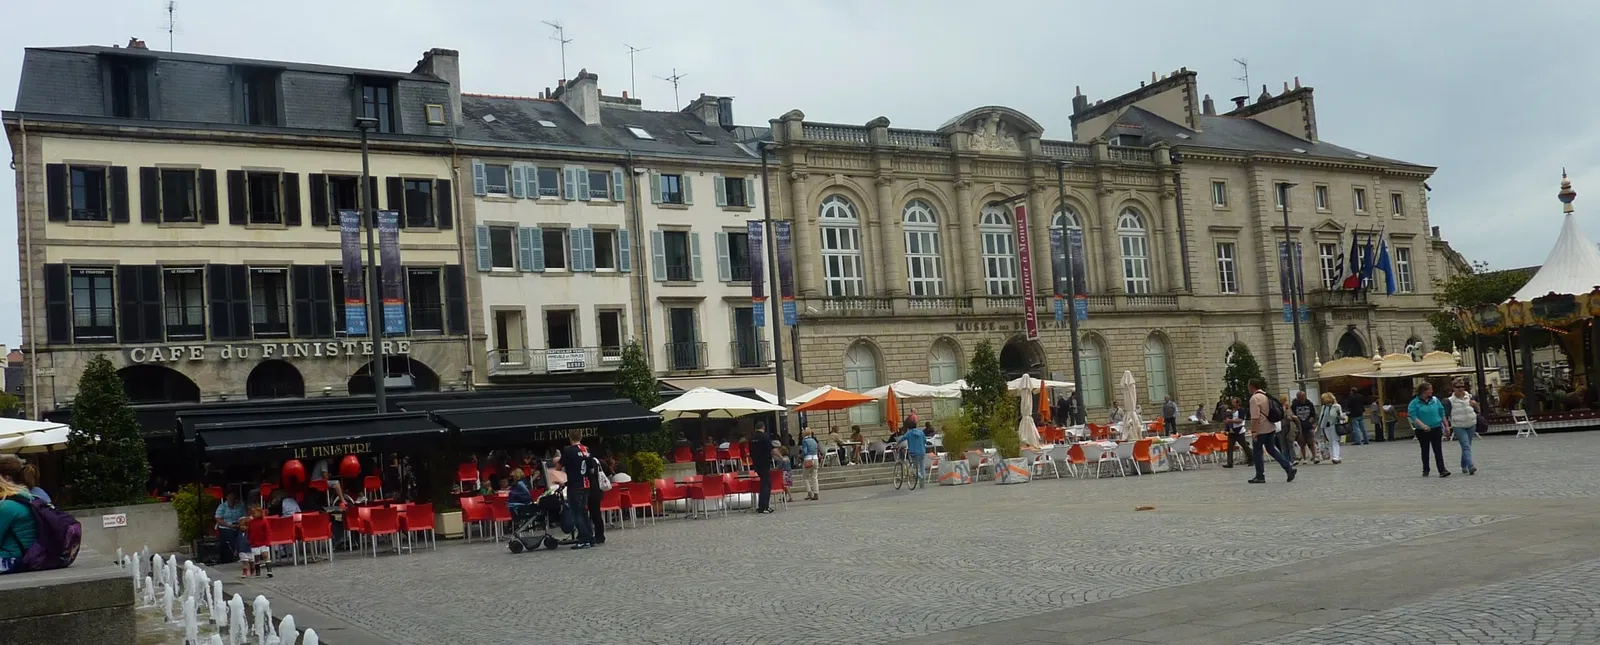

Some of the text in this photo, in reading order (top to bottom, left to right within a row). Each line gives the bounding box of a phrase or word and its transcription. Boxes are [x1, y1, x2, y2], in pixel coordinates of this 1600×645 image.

[1017, 219, 1027, 253] Monet
[1024, 266, 1032, 302] Turner
[1026, 306, 1034, 321] De
[130, 340, 411, 363] CAFE du FINISTERE
[534, 428, 598, 440] LE FINIERE
[294, 442, 372, 459] LE FINISTERE
